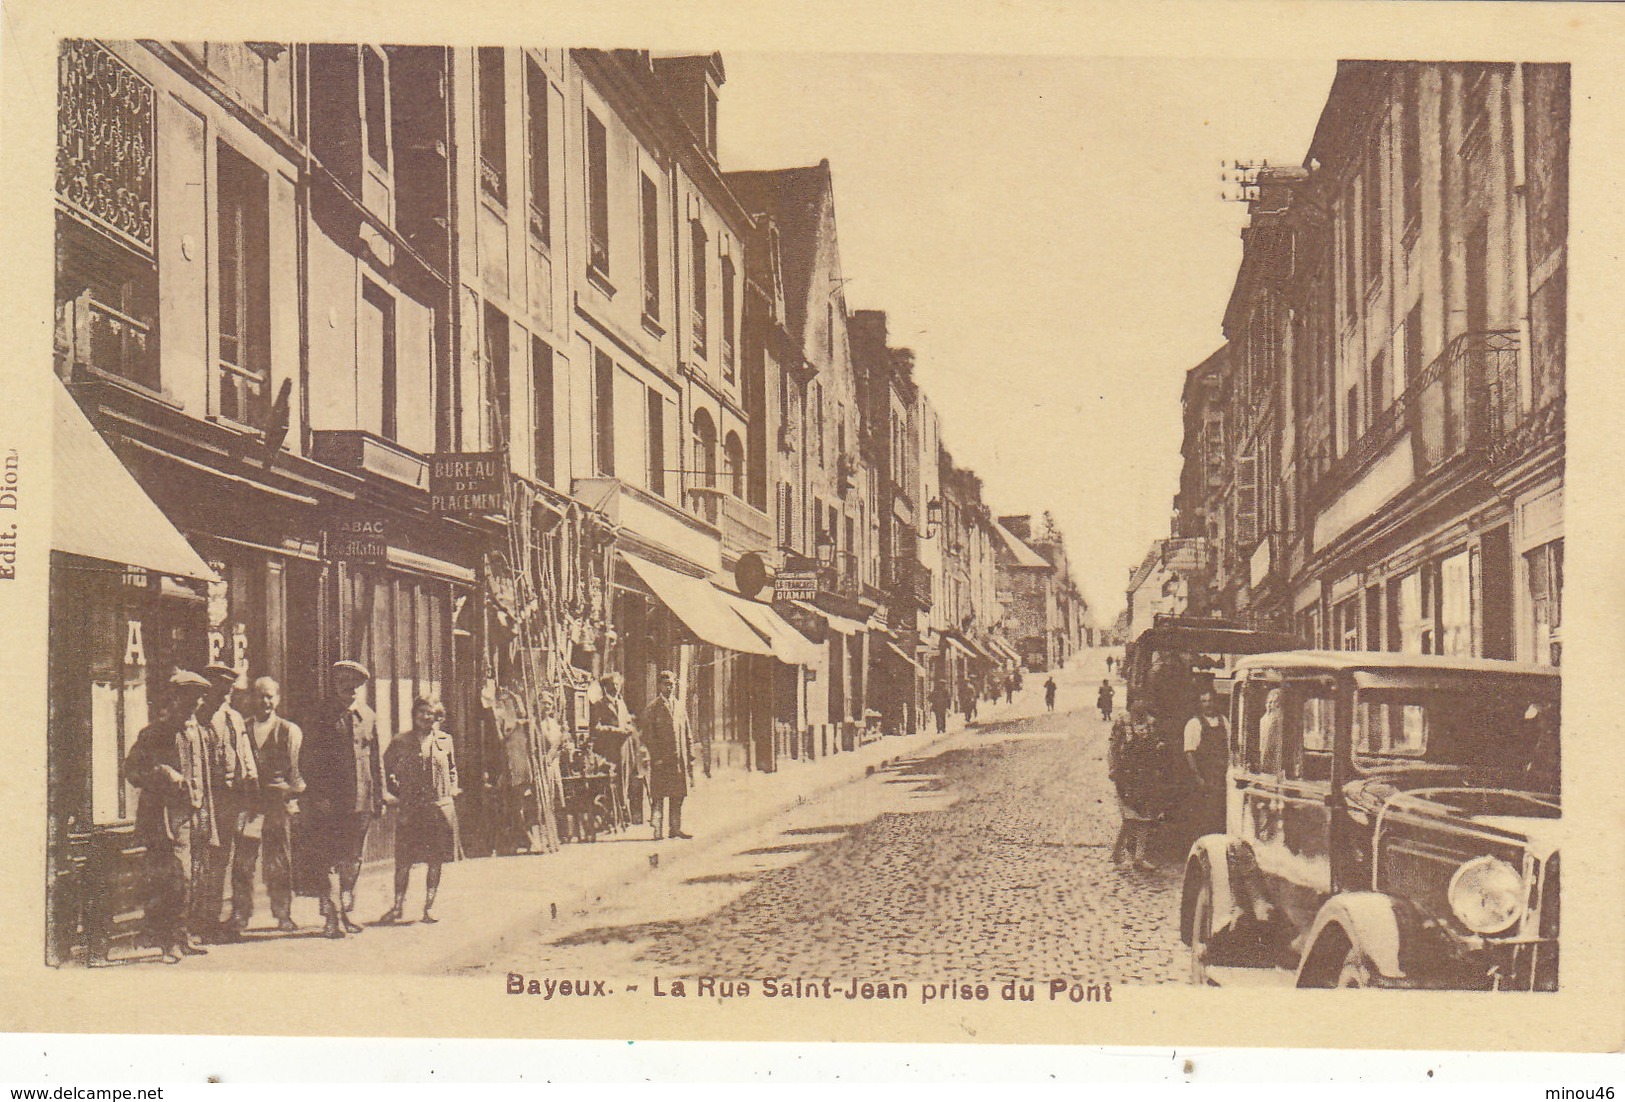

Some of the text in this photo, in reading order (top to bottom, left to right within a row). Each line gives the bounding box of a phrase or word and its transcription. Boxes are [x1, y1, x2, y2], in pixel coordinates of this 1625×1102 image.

[434, 460, 496, 478] BUREAU
[455, 481, 479, 491] DE
[431, 493, 502, 511] PLACEMENT
[776, 590, 817, 601] DIAMANT
